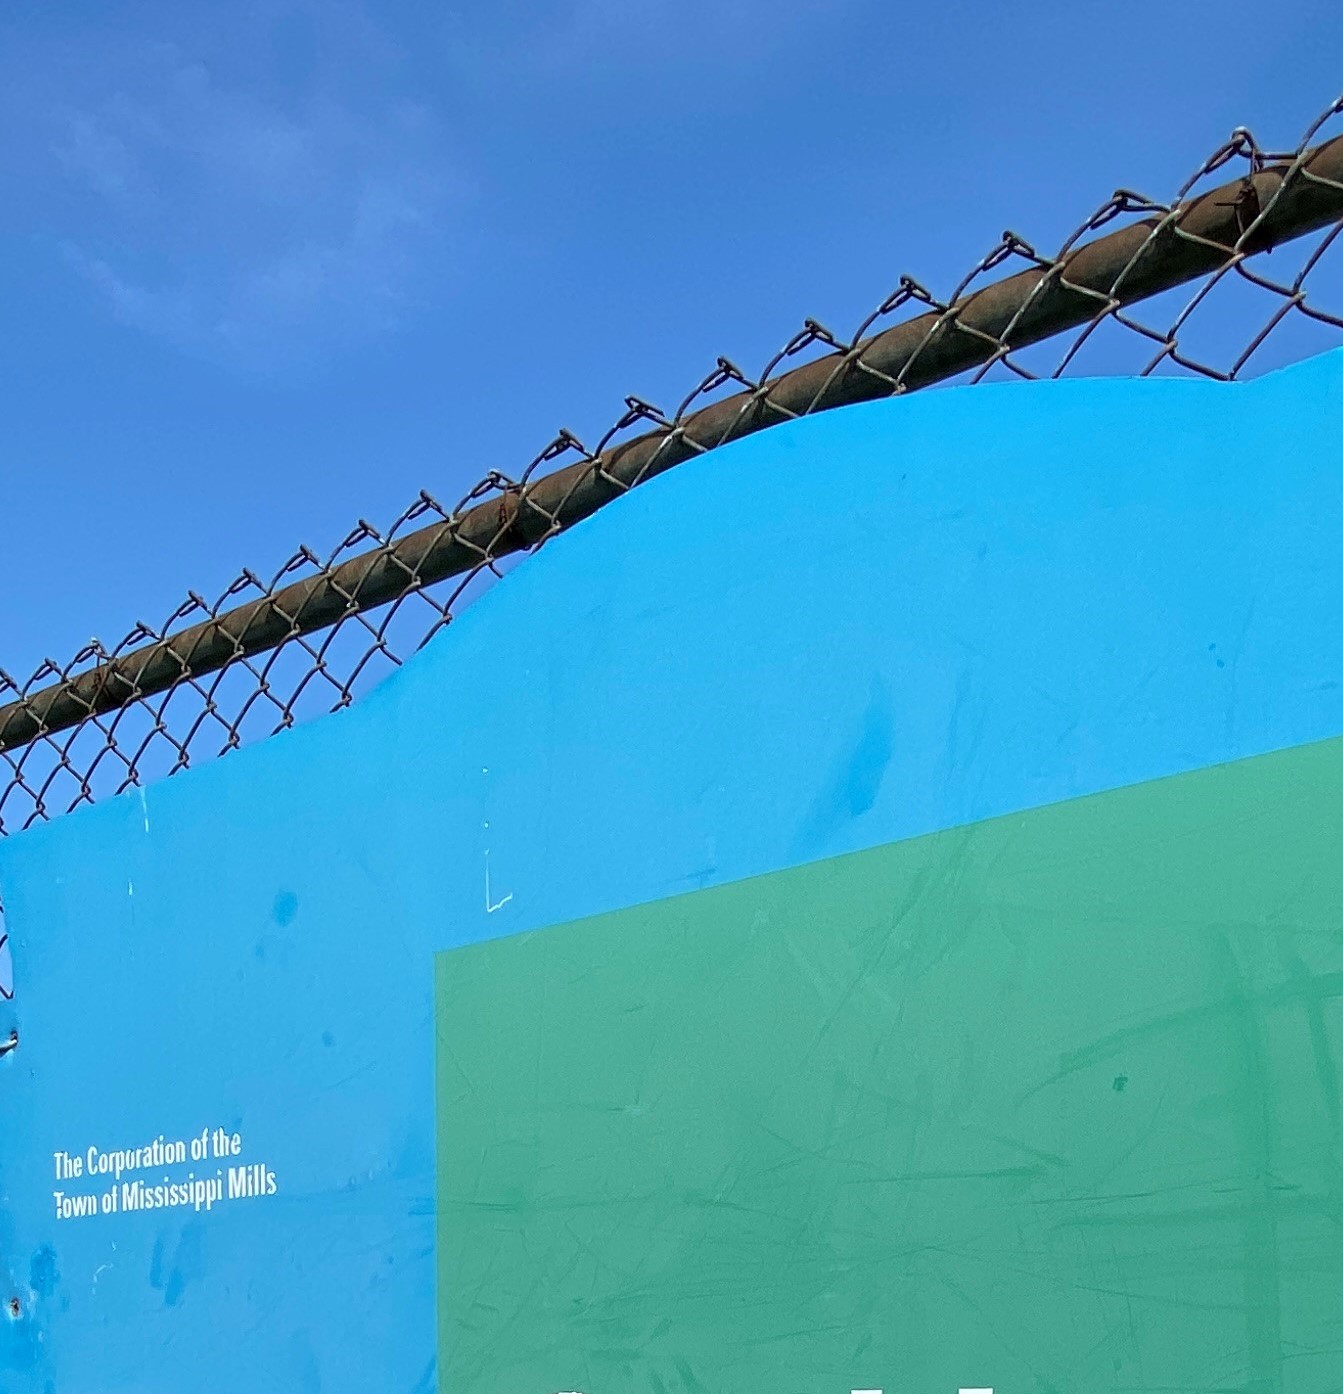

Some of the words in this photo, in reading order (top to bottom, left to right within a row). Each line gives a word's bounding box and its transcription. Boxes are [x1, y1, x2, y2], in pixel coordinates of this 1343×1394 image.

[53, 1151, 83, 1180] The
[87, 1134, 186, 1180] Corporation
[191, 1127, 209, 1161] of
[212, 1126, 242, 1158] the
[53, 1190, 98, 1220] Town
[101, 1184, 118, 1214] of
[122, 1169, 223, 1212] Mississippi
[228, 1163, 278, 1200] Mills
